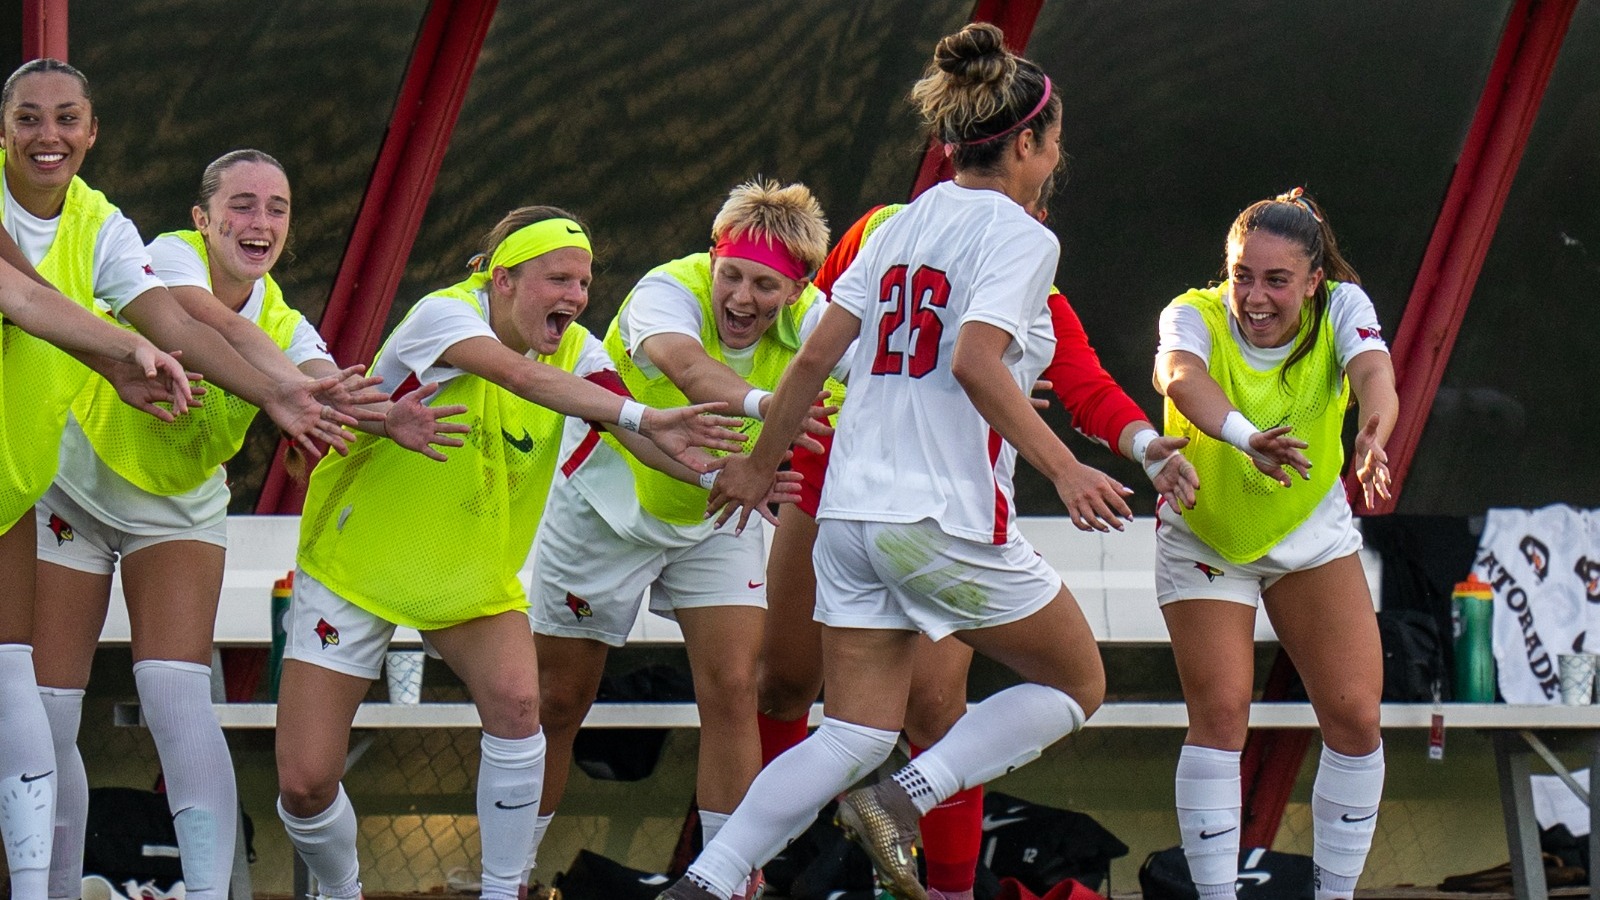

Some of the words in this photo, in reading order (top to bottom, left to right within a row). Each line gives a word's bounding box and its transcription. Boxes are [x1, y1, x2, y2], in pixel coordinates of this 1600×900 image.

[871, 264, 952, 379] 26
[1477, 550, 1562, 701] ATORADE
[1022, 848, 1038, 863] 12
